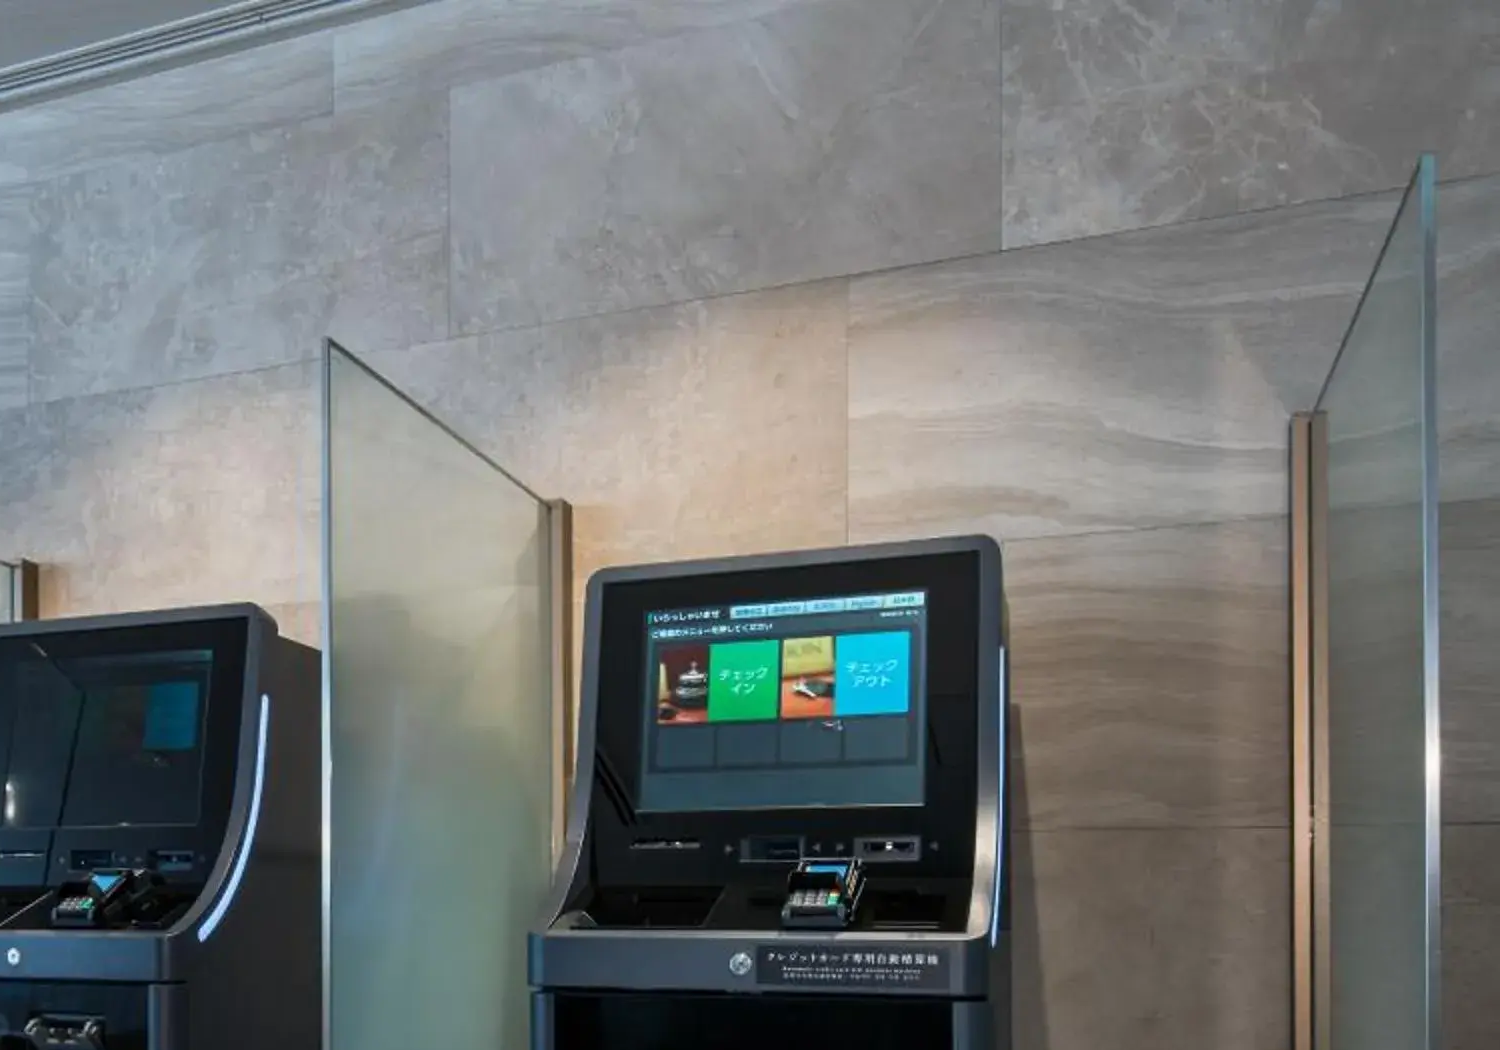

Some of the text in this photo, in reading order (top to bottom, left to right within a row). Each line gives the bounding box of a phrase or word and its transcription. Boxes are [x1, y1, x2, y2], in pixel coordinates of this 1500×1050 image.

[718, 665, 769, 681] チェック
[845, 659, 898, 673] チェック
[852, 675, 892, 688] アウト
[730, 682, 756, 696] イン
